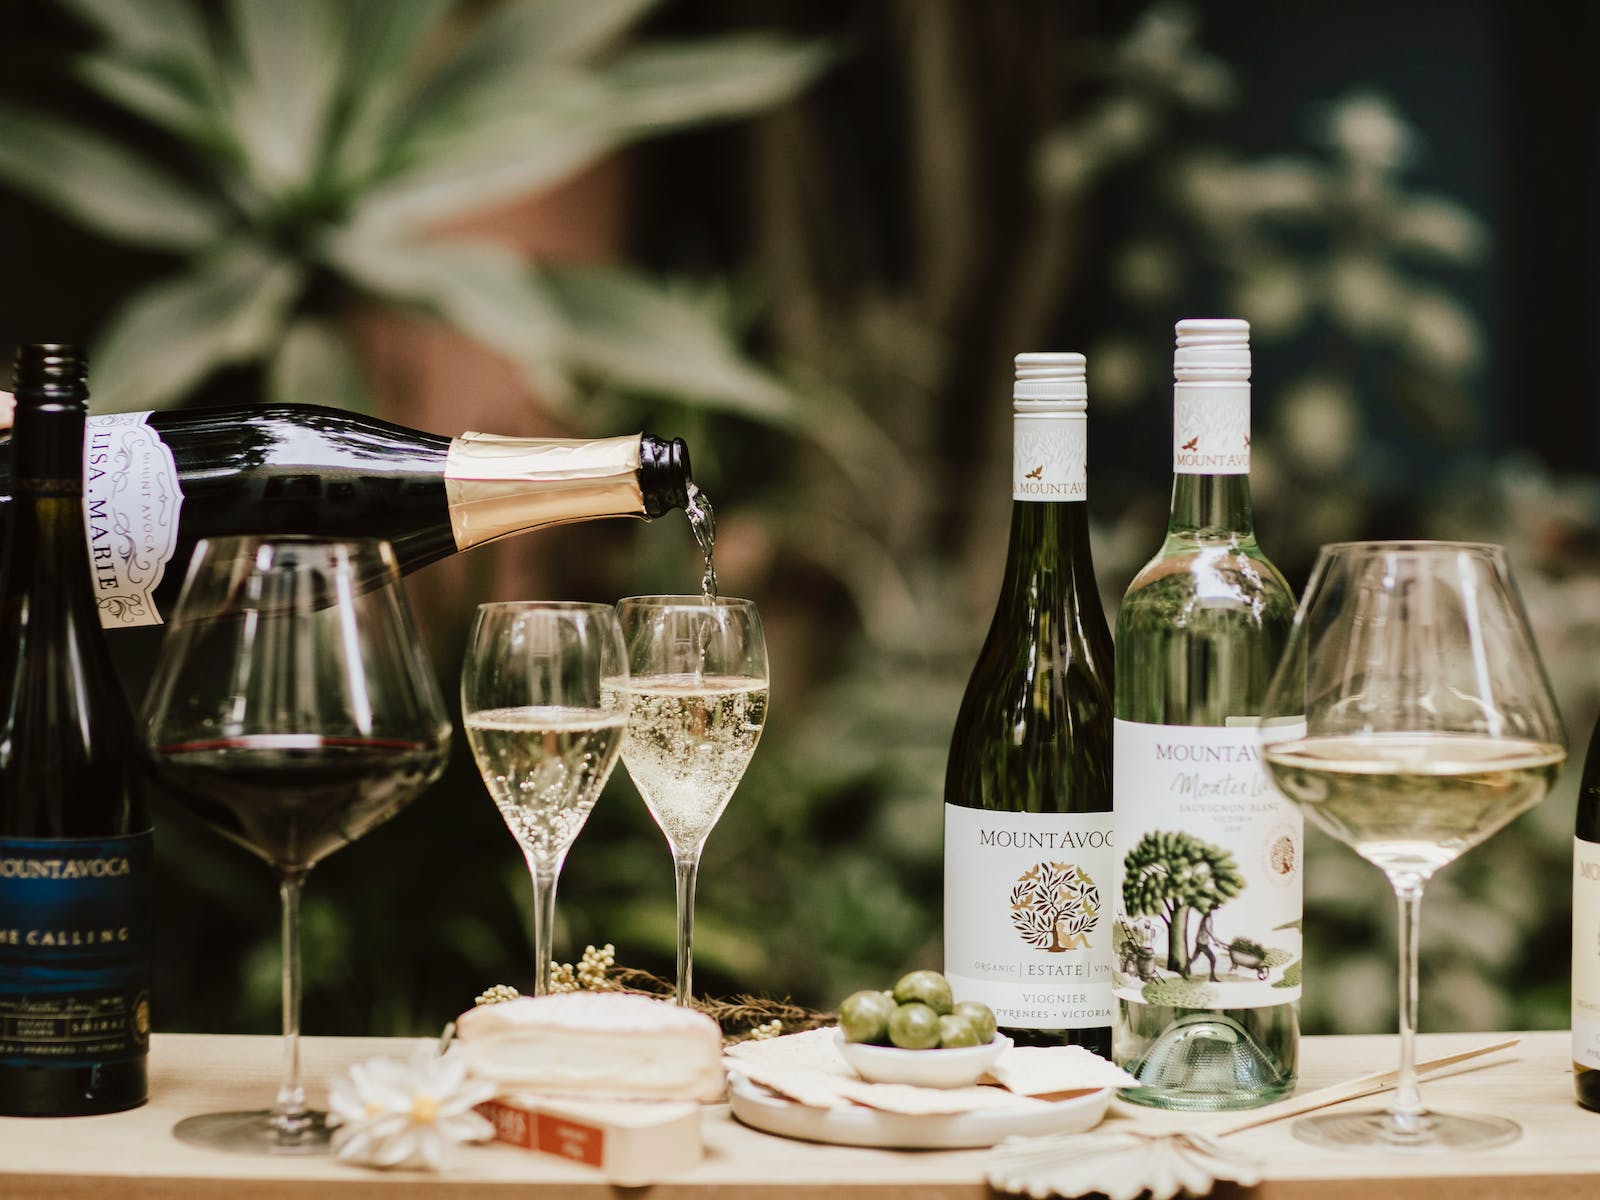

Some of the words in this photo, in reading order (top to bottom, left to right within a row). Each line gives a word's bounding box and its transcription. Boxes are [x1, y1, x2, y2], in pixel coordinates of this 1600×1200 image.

[0, 858, 130, 879] OUNTAVOCA
[26, 927, 128, 946] CALLING
[973, 961, 1016, 973] ORGANIC
[1028, 964, 1083, 976] ESTATE
[1022, 993, 1088, 1004] VIOGNIER
[1062, 1008, 1112, 1018] VICTORIA
